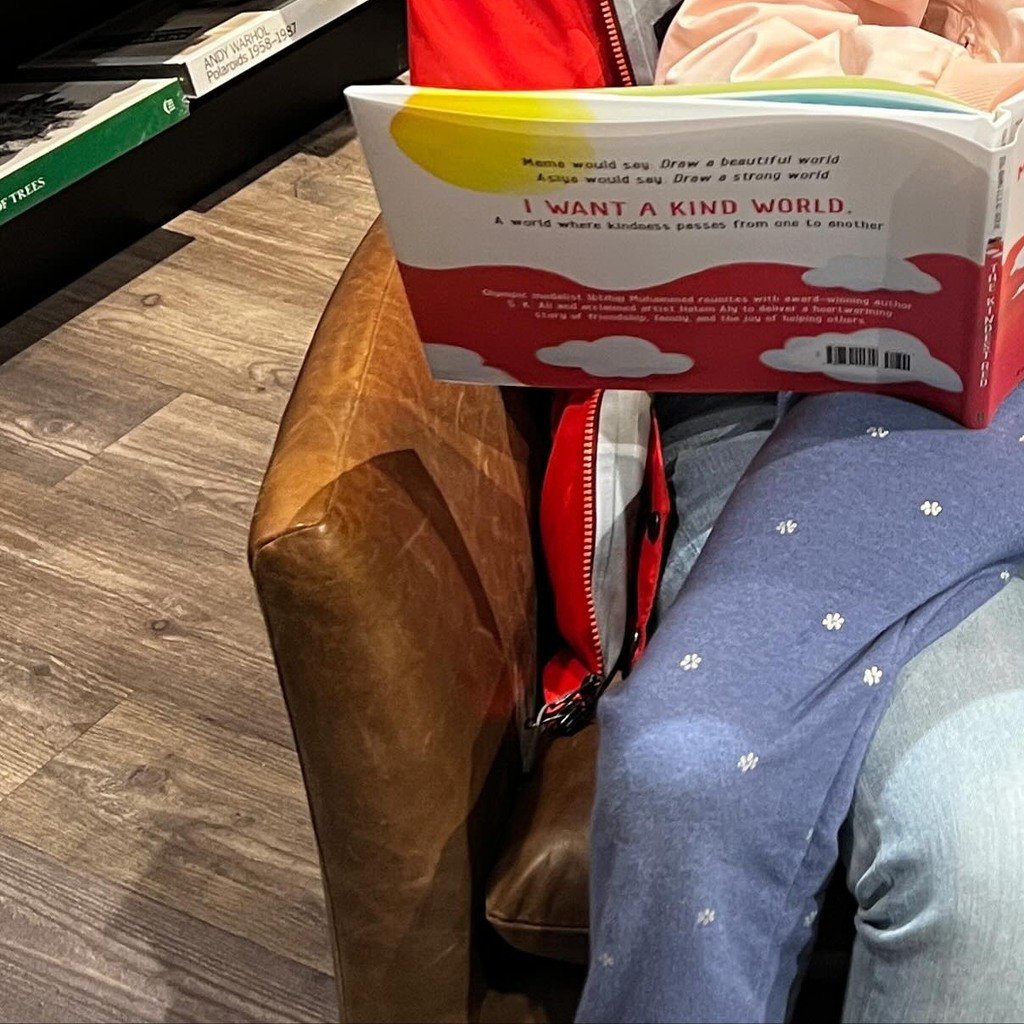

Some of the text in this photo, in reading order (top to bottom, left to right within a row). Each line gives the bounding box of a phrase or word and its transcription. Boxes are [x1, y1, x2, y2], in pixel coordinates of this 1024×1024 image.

[203, 27, 271, 70] ANDY WARHOL
[206, 55, 248, 83] Polaroids
[573, 161, 617, 170] would
[661, 157, 700, 170] Draw
[721, 155, 792, 167] beautiful
[799, 155, 840, 165] world
[586, 174, 630, 184] would
[673, 172, 711, 184] Draw
[719, 174, 726, 182] a
[734, 171, 781, 181] strong
[788, 170, 830, 180] world
[8, 177, 45, 205] TREES
[524, 198, 852, 217] I WANT A KIND WORLD.
[495, 216, 504, 225] A
[511, 219, 551, 227] world
[559, 220, 602, 229] where
[608, 222, 670, 231] kindness
[677, 220, 726, 232] passes
[733, 219, 769, 228] from
[806, 219, 822, 227] to
[828, 220, 885, 231] another
